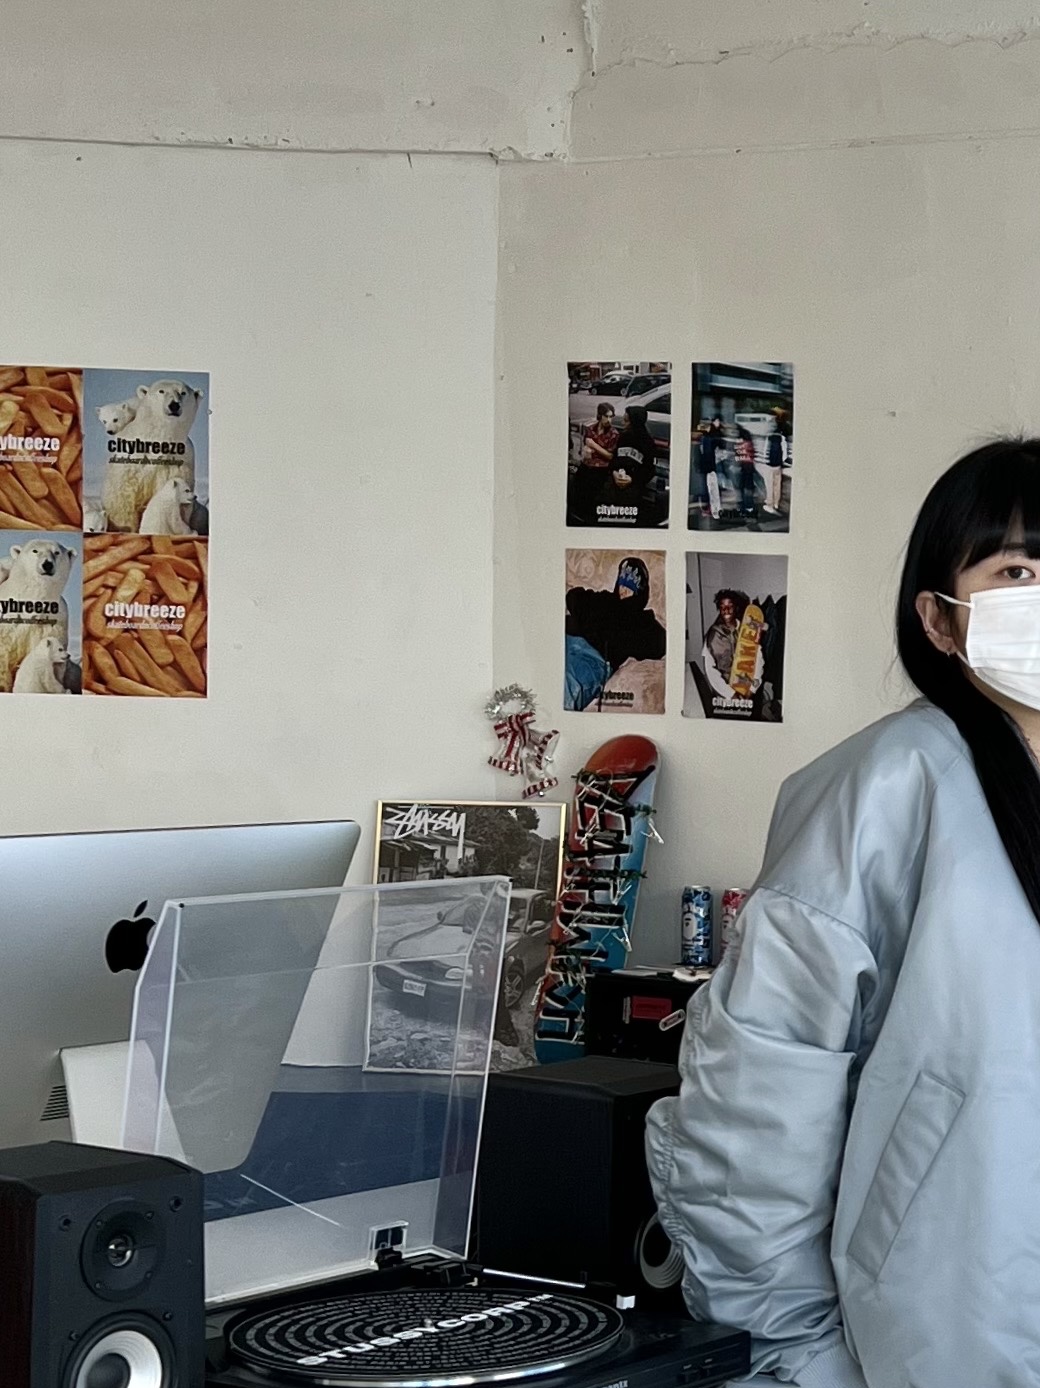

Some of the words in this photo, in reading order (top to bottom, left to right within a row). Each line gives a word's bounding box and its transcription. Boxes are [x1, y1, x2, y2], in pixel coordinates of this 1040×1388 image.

[107, 438, 186, 455] citybreeze
[596, 504, 639, 515] citybreeze
[104, 602, 186, 619] citybreeze
[712, 696, 754, 708] citybreeze
